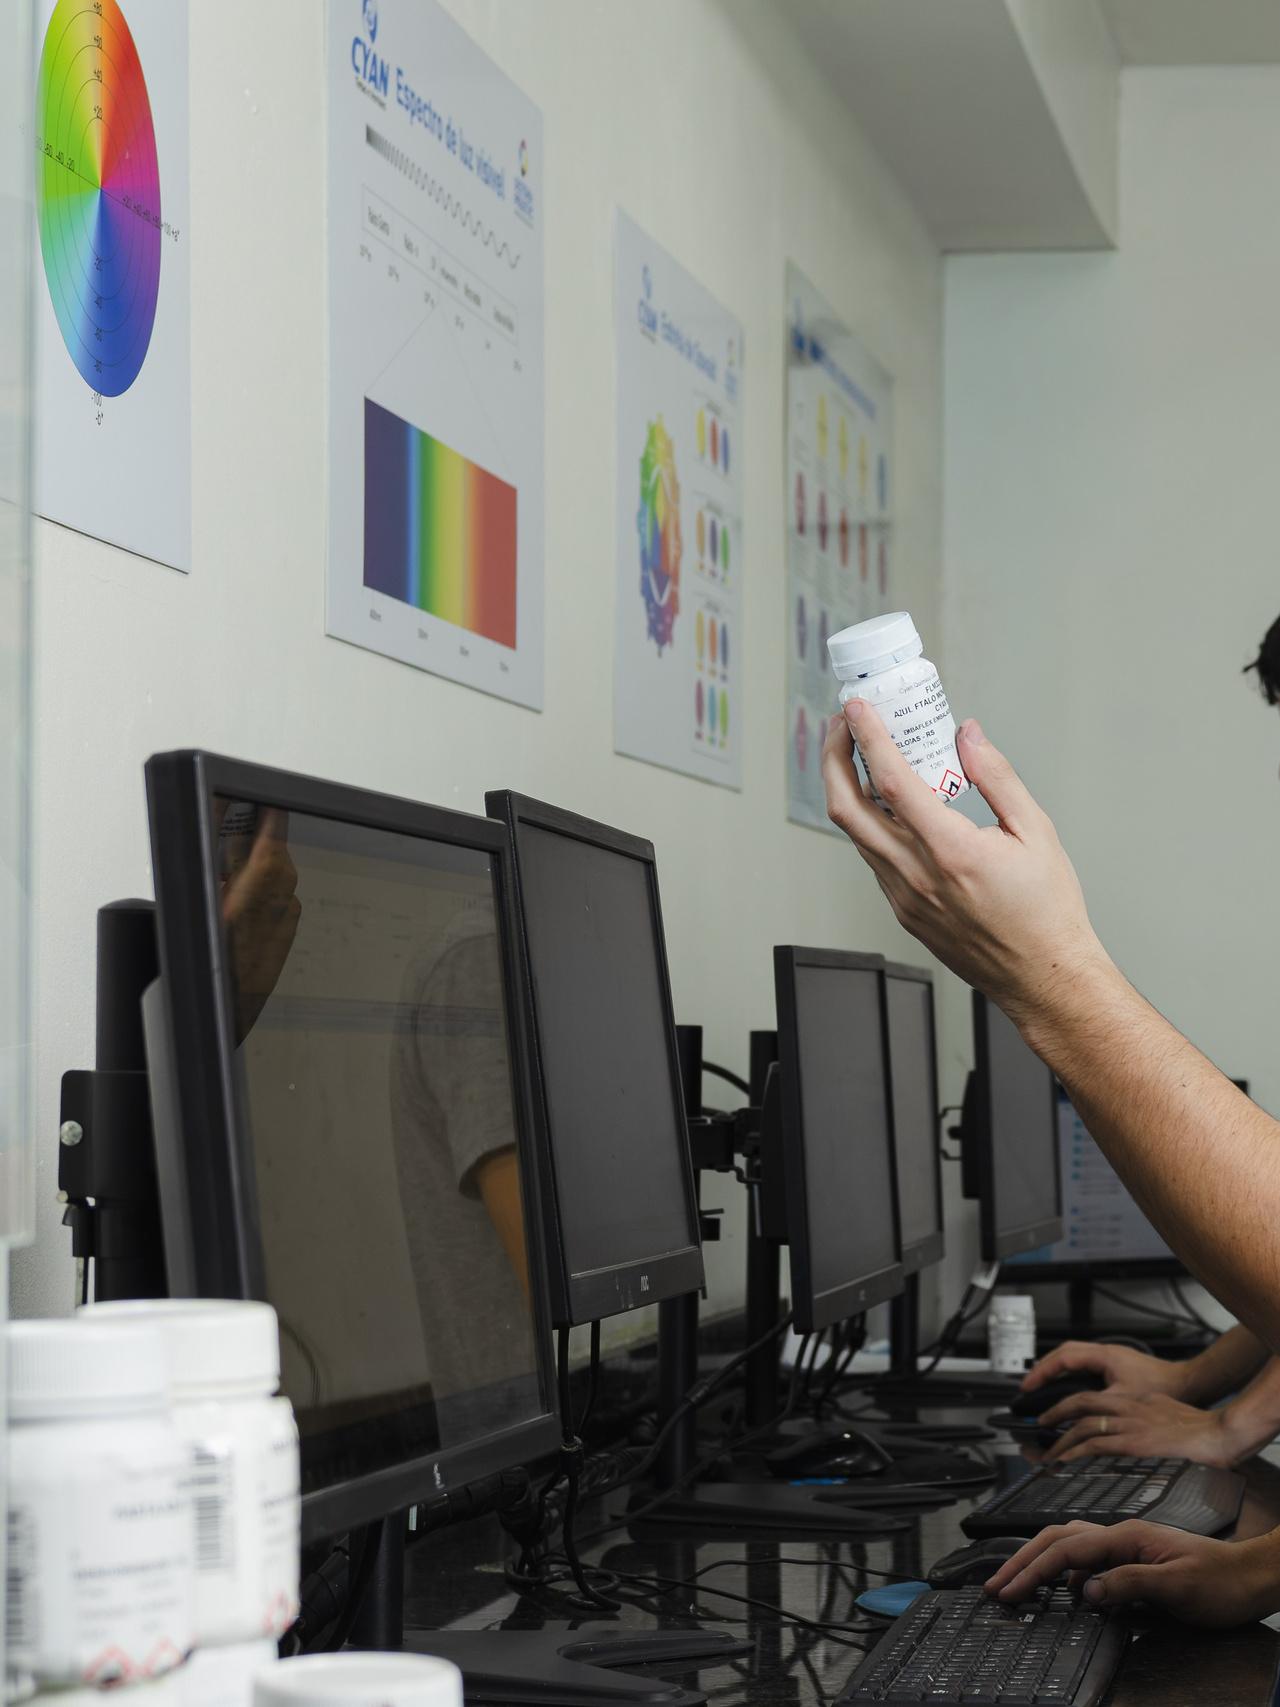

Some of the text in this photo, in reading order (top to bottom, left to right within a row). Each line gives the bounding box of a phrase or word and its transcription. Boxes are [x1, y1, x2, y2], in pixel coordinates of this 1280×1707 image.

[352, 36, 390, 97] CYAN
[396, 66, 443, 142] Espectro
[446, 116, 457, 155] de
[459, 127, 474, 172] luz
[894, 706, 914, 718] AZUL
[914, 694, 937, 710] FTALO
[896, 735, 922, 749] ELOTAS
[925, 729, 936, 738] RS
[922, 737, 940, 749] 17KG
[935, 742, 955, 756] MESES
